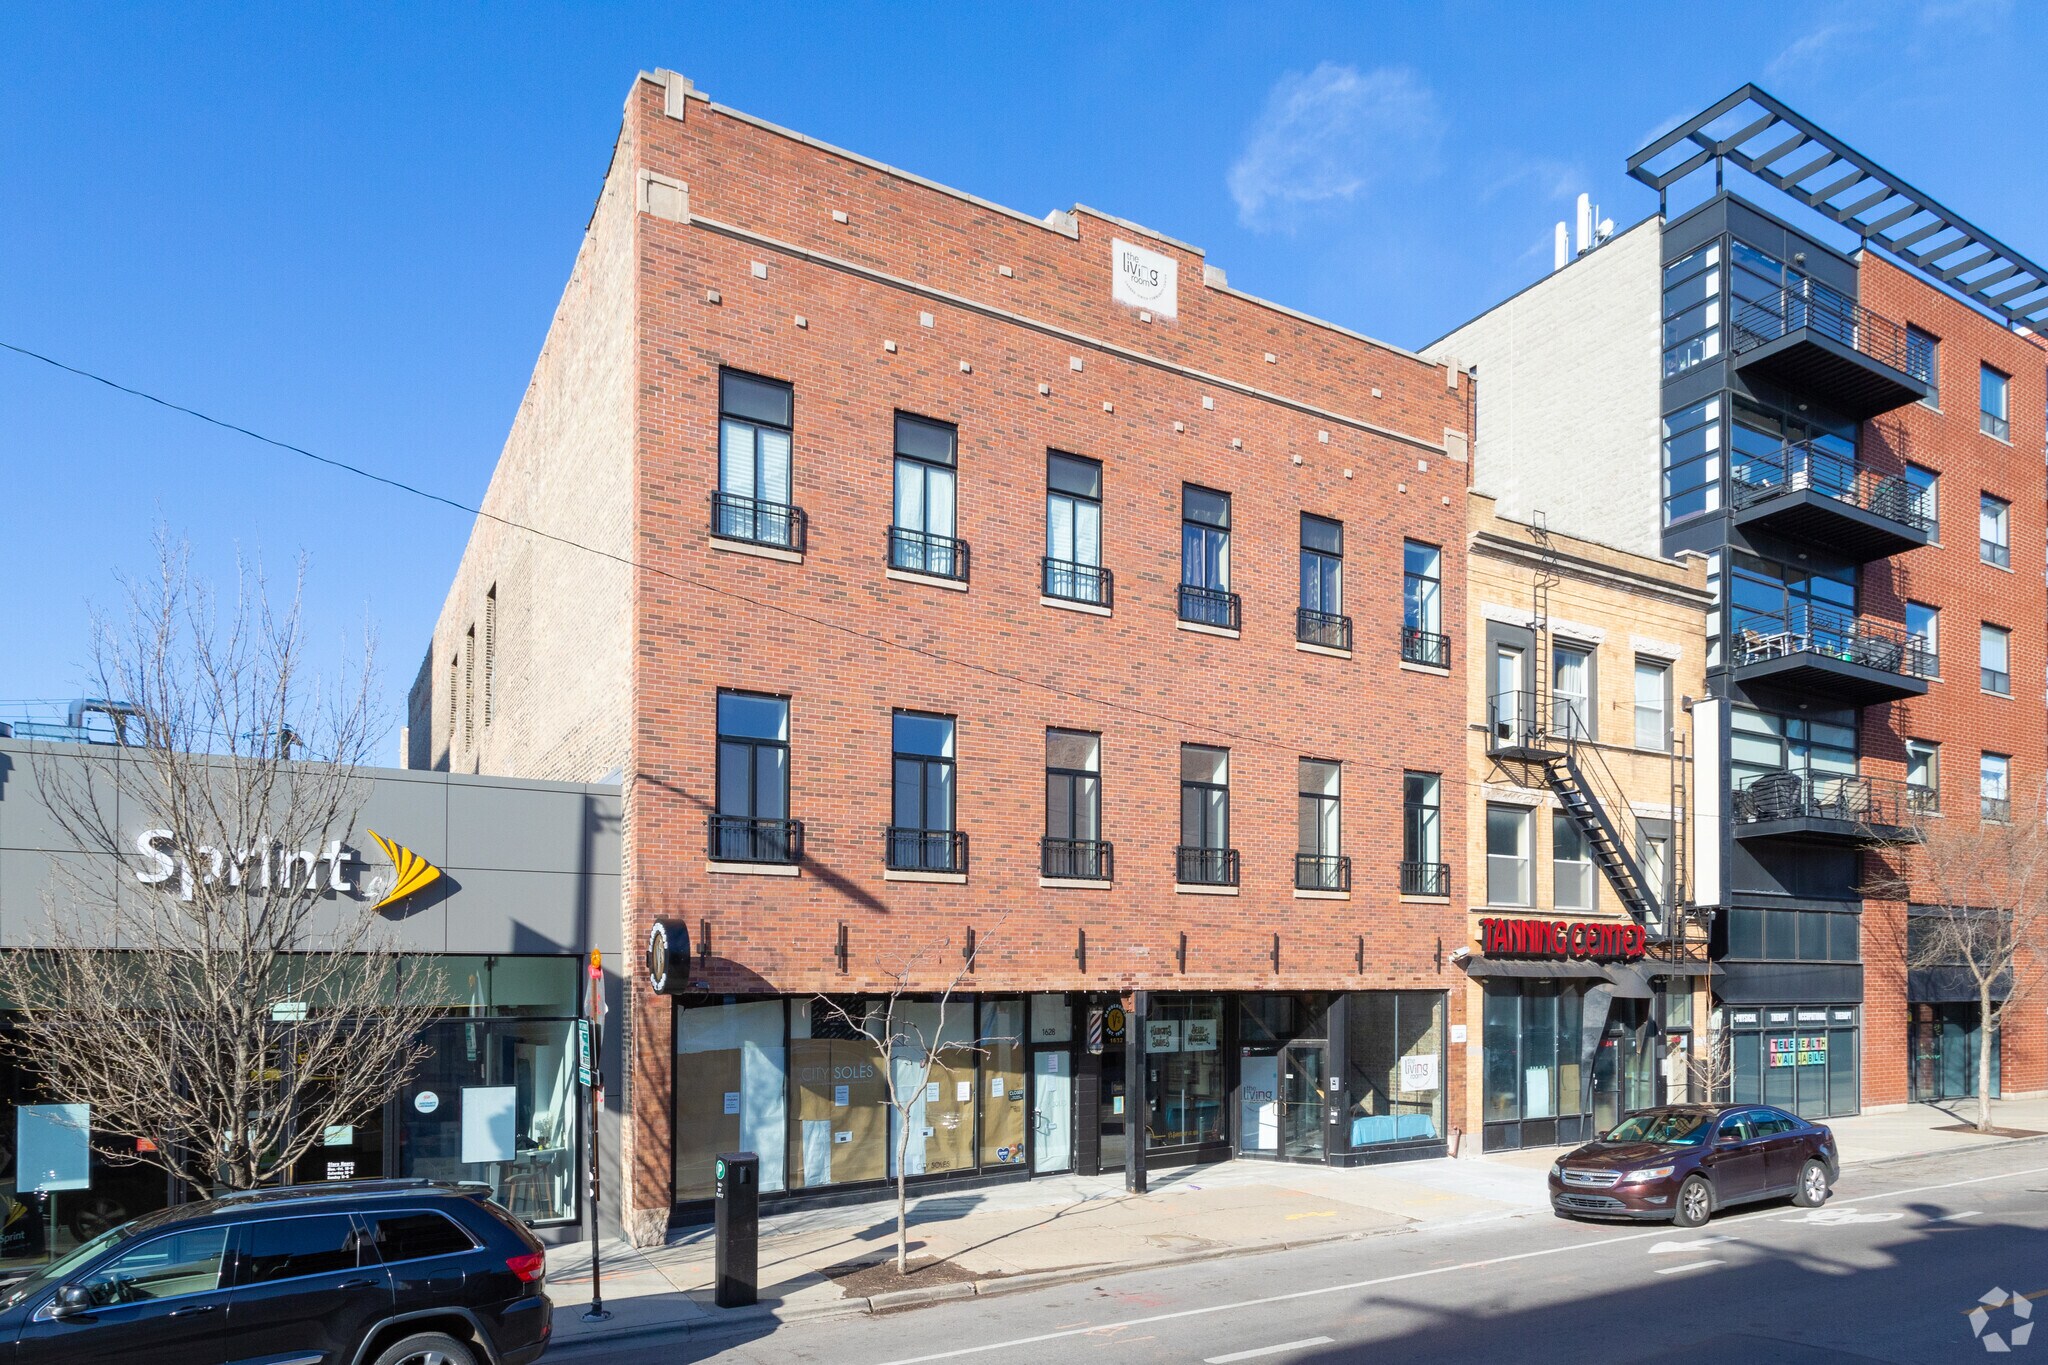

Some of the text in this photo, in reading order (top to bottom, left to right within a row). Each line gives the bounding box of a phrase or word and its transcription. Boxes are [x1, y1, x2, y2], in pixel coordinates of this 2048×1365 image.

[1126, 252, 1140, 263] the
[1122, 252, 1159, 287] living
[1130, 275, 1150, 288] room
[135, 829, 352, 902] Sprint
[1481, 917, 1647, 956] TANNING CENTER
[1770, 1013, 1789, 1021] THERAPY
[1834, 1011, 1852, 1020] THERAPY
[1042, 1028, 1056, 1036] 1628
[802, 1065, 874, 1082] CITY SOLES
[1405, 1060, 1429, 1076] living
[1243, 1086, 1273, 1102] living
